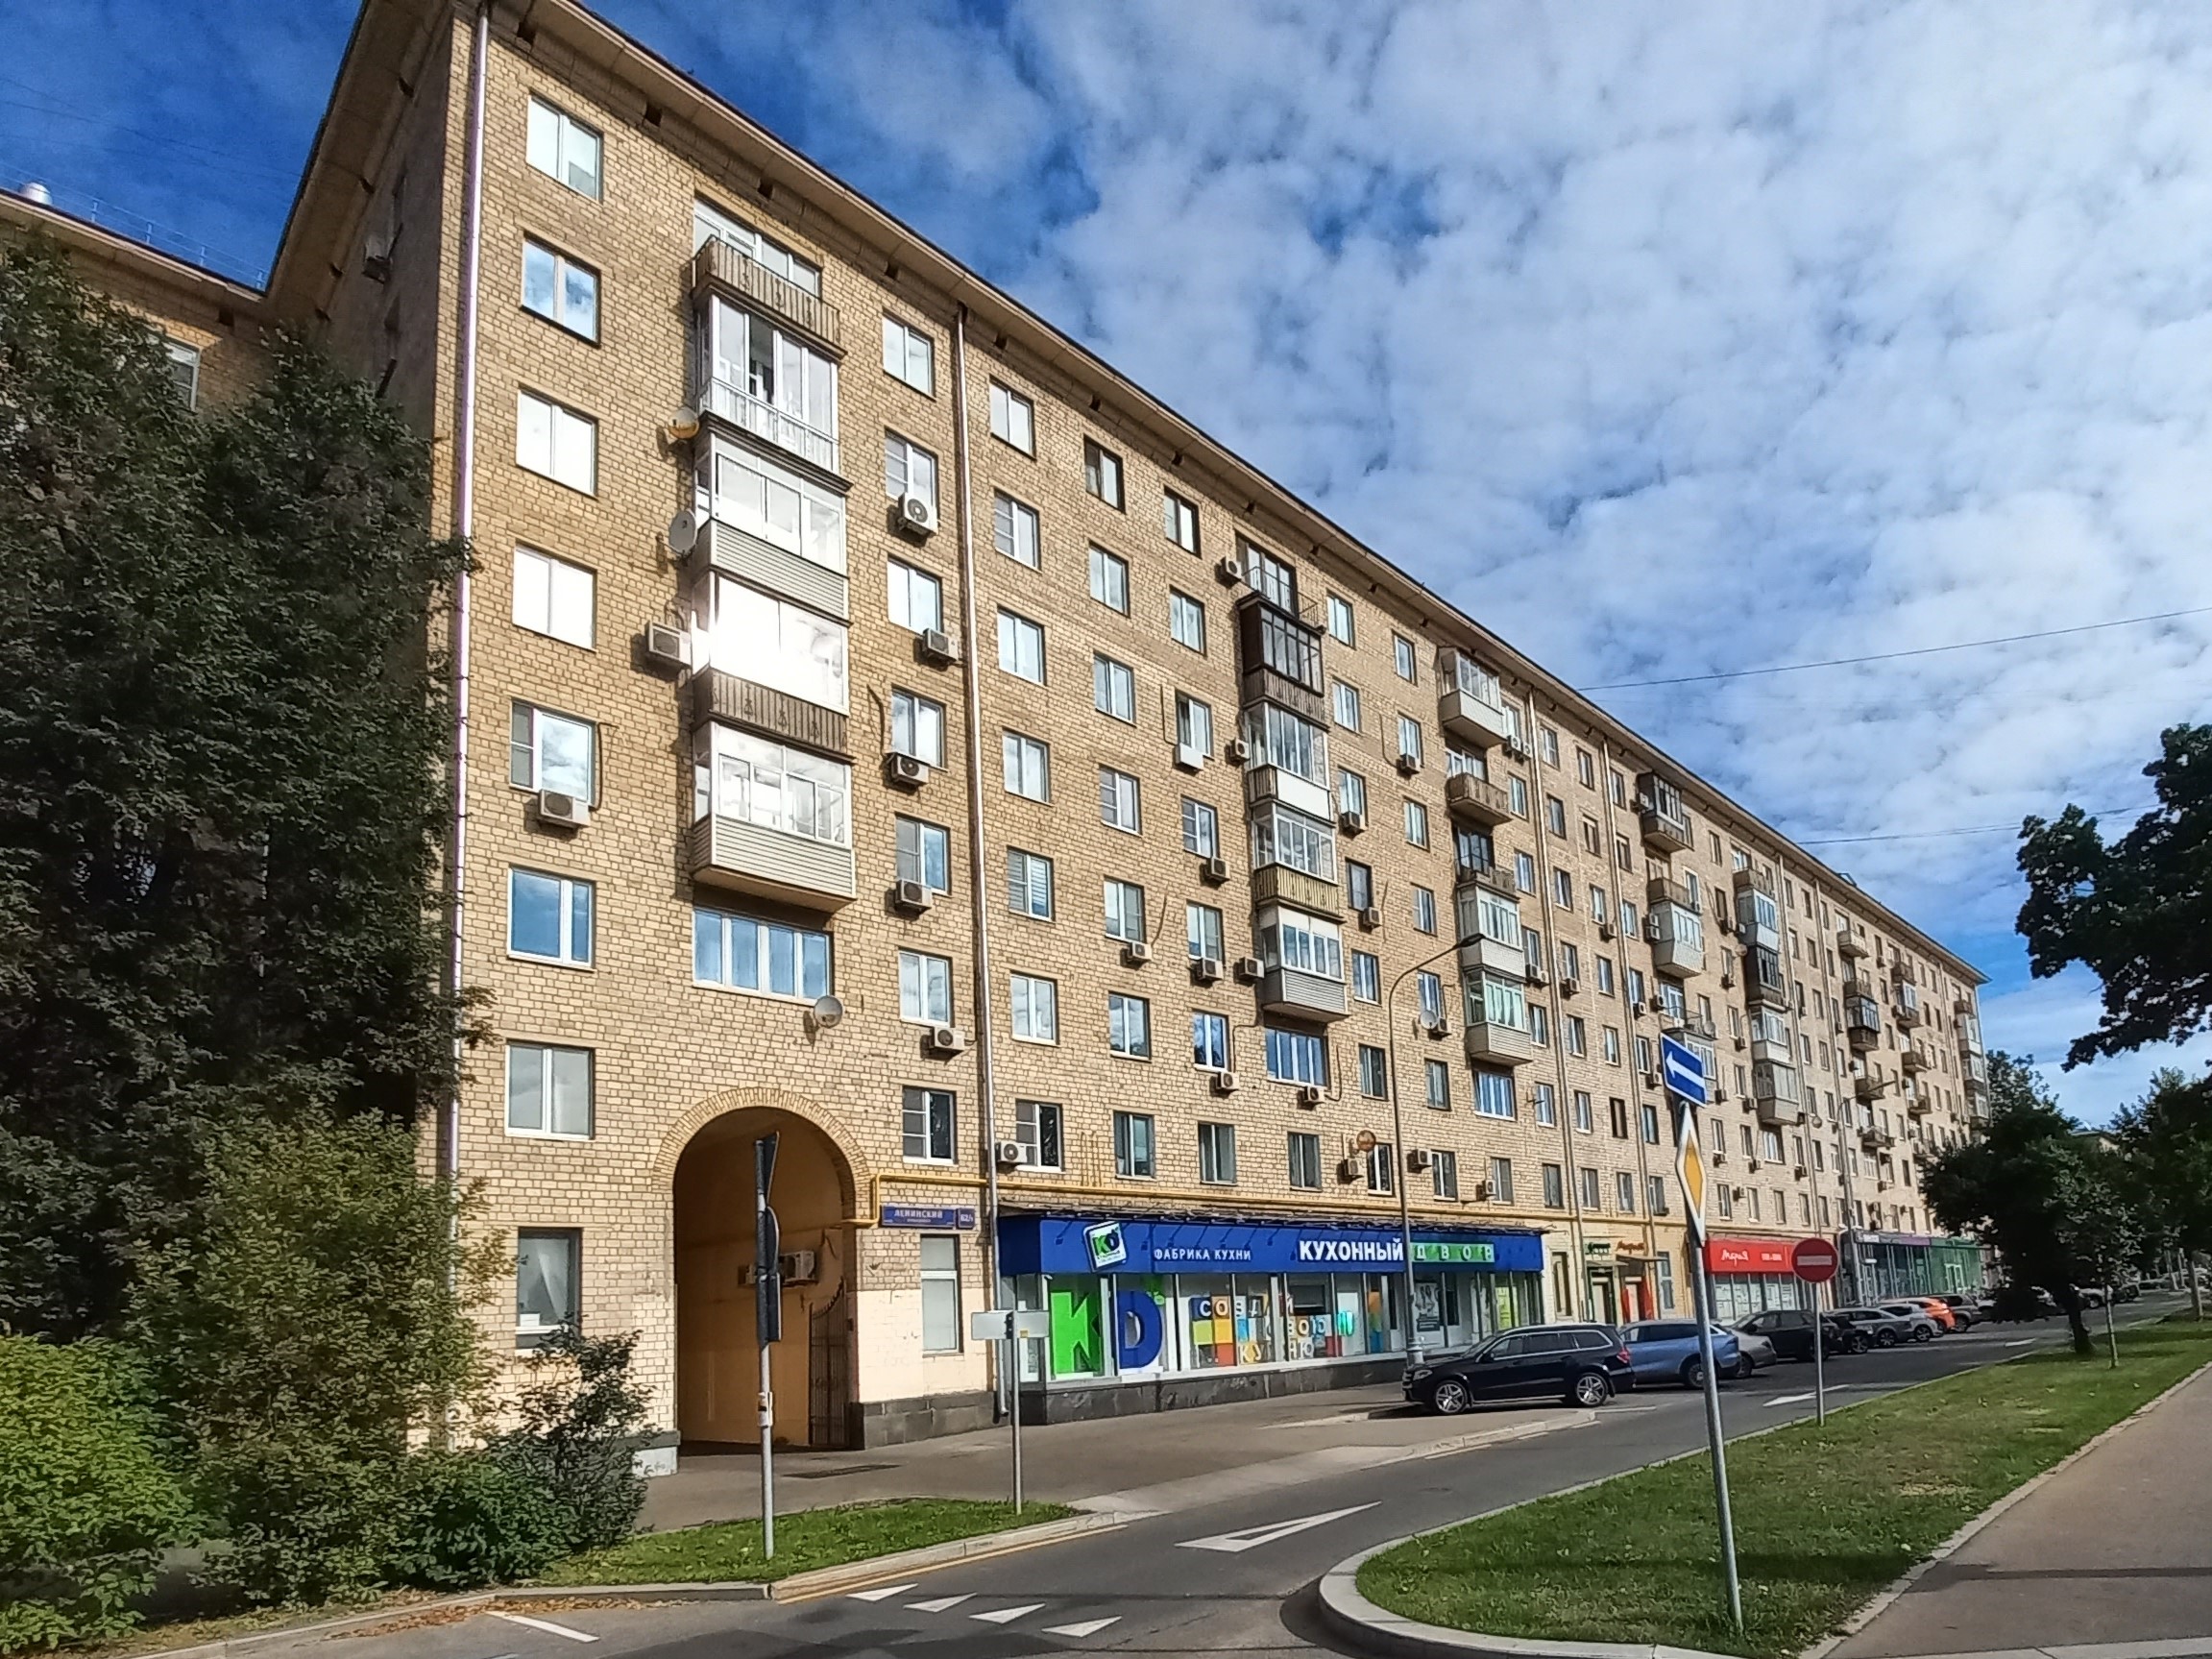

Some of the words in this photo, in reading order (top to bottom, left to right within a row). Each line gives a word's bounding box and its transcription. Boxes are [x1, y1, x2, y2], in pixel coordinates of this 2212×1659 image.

[894, 1209, 943, 1219] ЛЕНИНСКИЙ
[1154, 1248, 1210, 1260] ФАБРИКА
[1214, 1250, 1252, 1260] КУХНИ
[1299, 1237, 1404, 1261] КУХОННЫЙ
